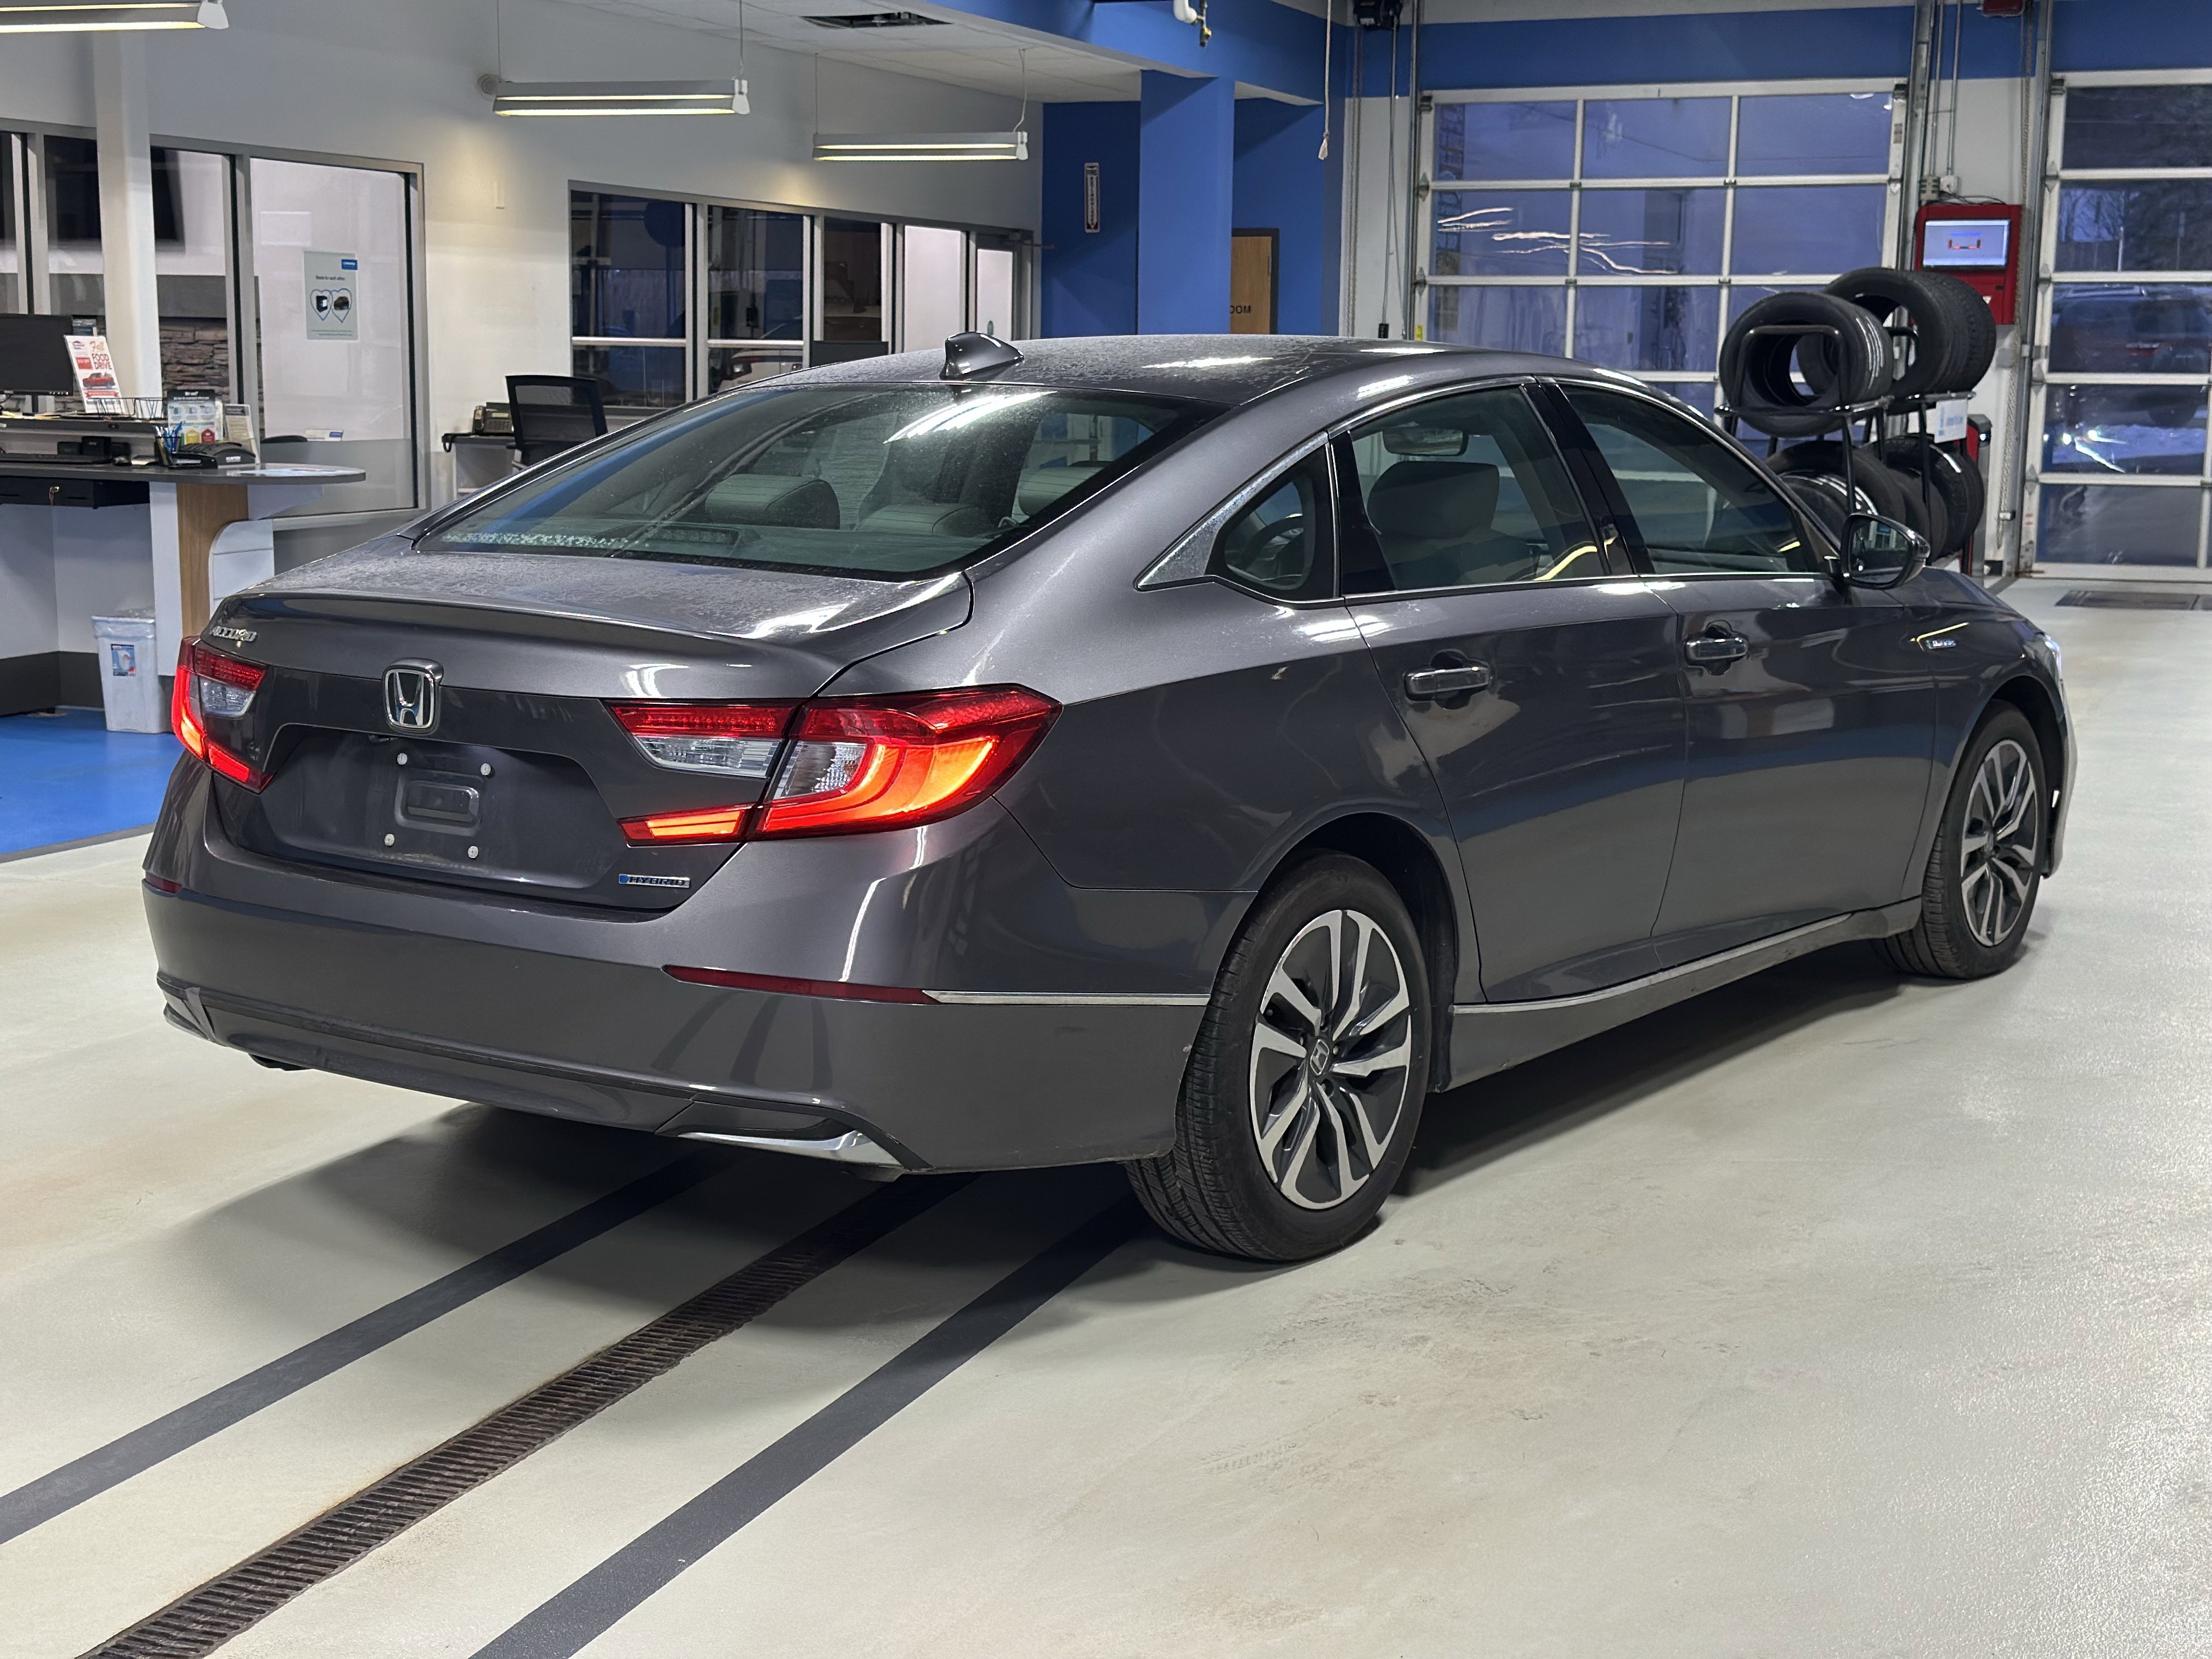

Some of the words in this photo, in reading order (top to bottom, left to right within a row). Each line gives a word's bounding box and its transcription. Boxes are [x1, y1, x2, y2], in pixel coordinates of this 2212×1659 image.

[94, 362, 112, 370] DRIVE
[210, 625, 257, 642] ACCORD
[629, 876, 686, 886] HYBRID
